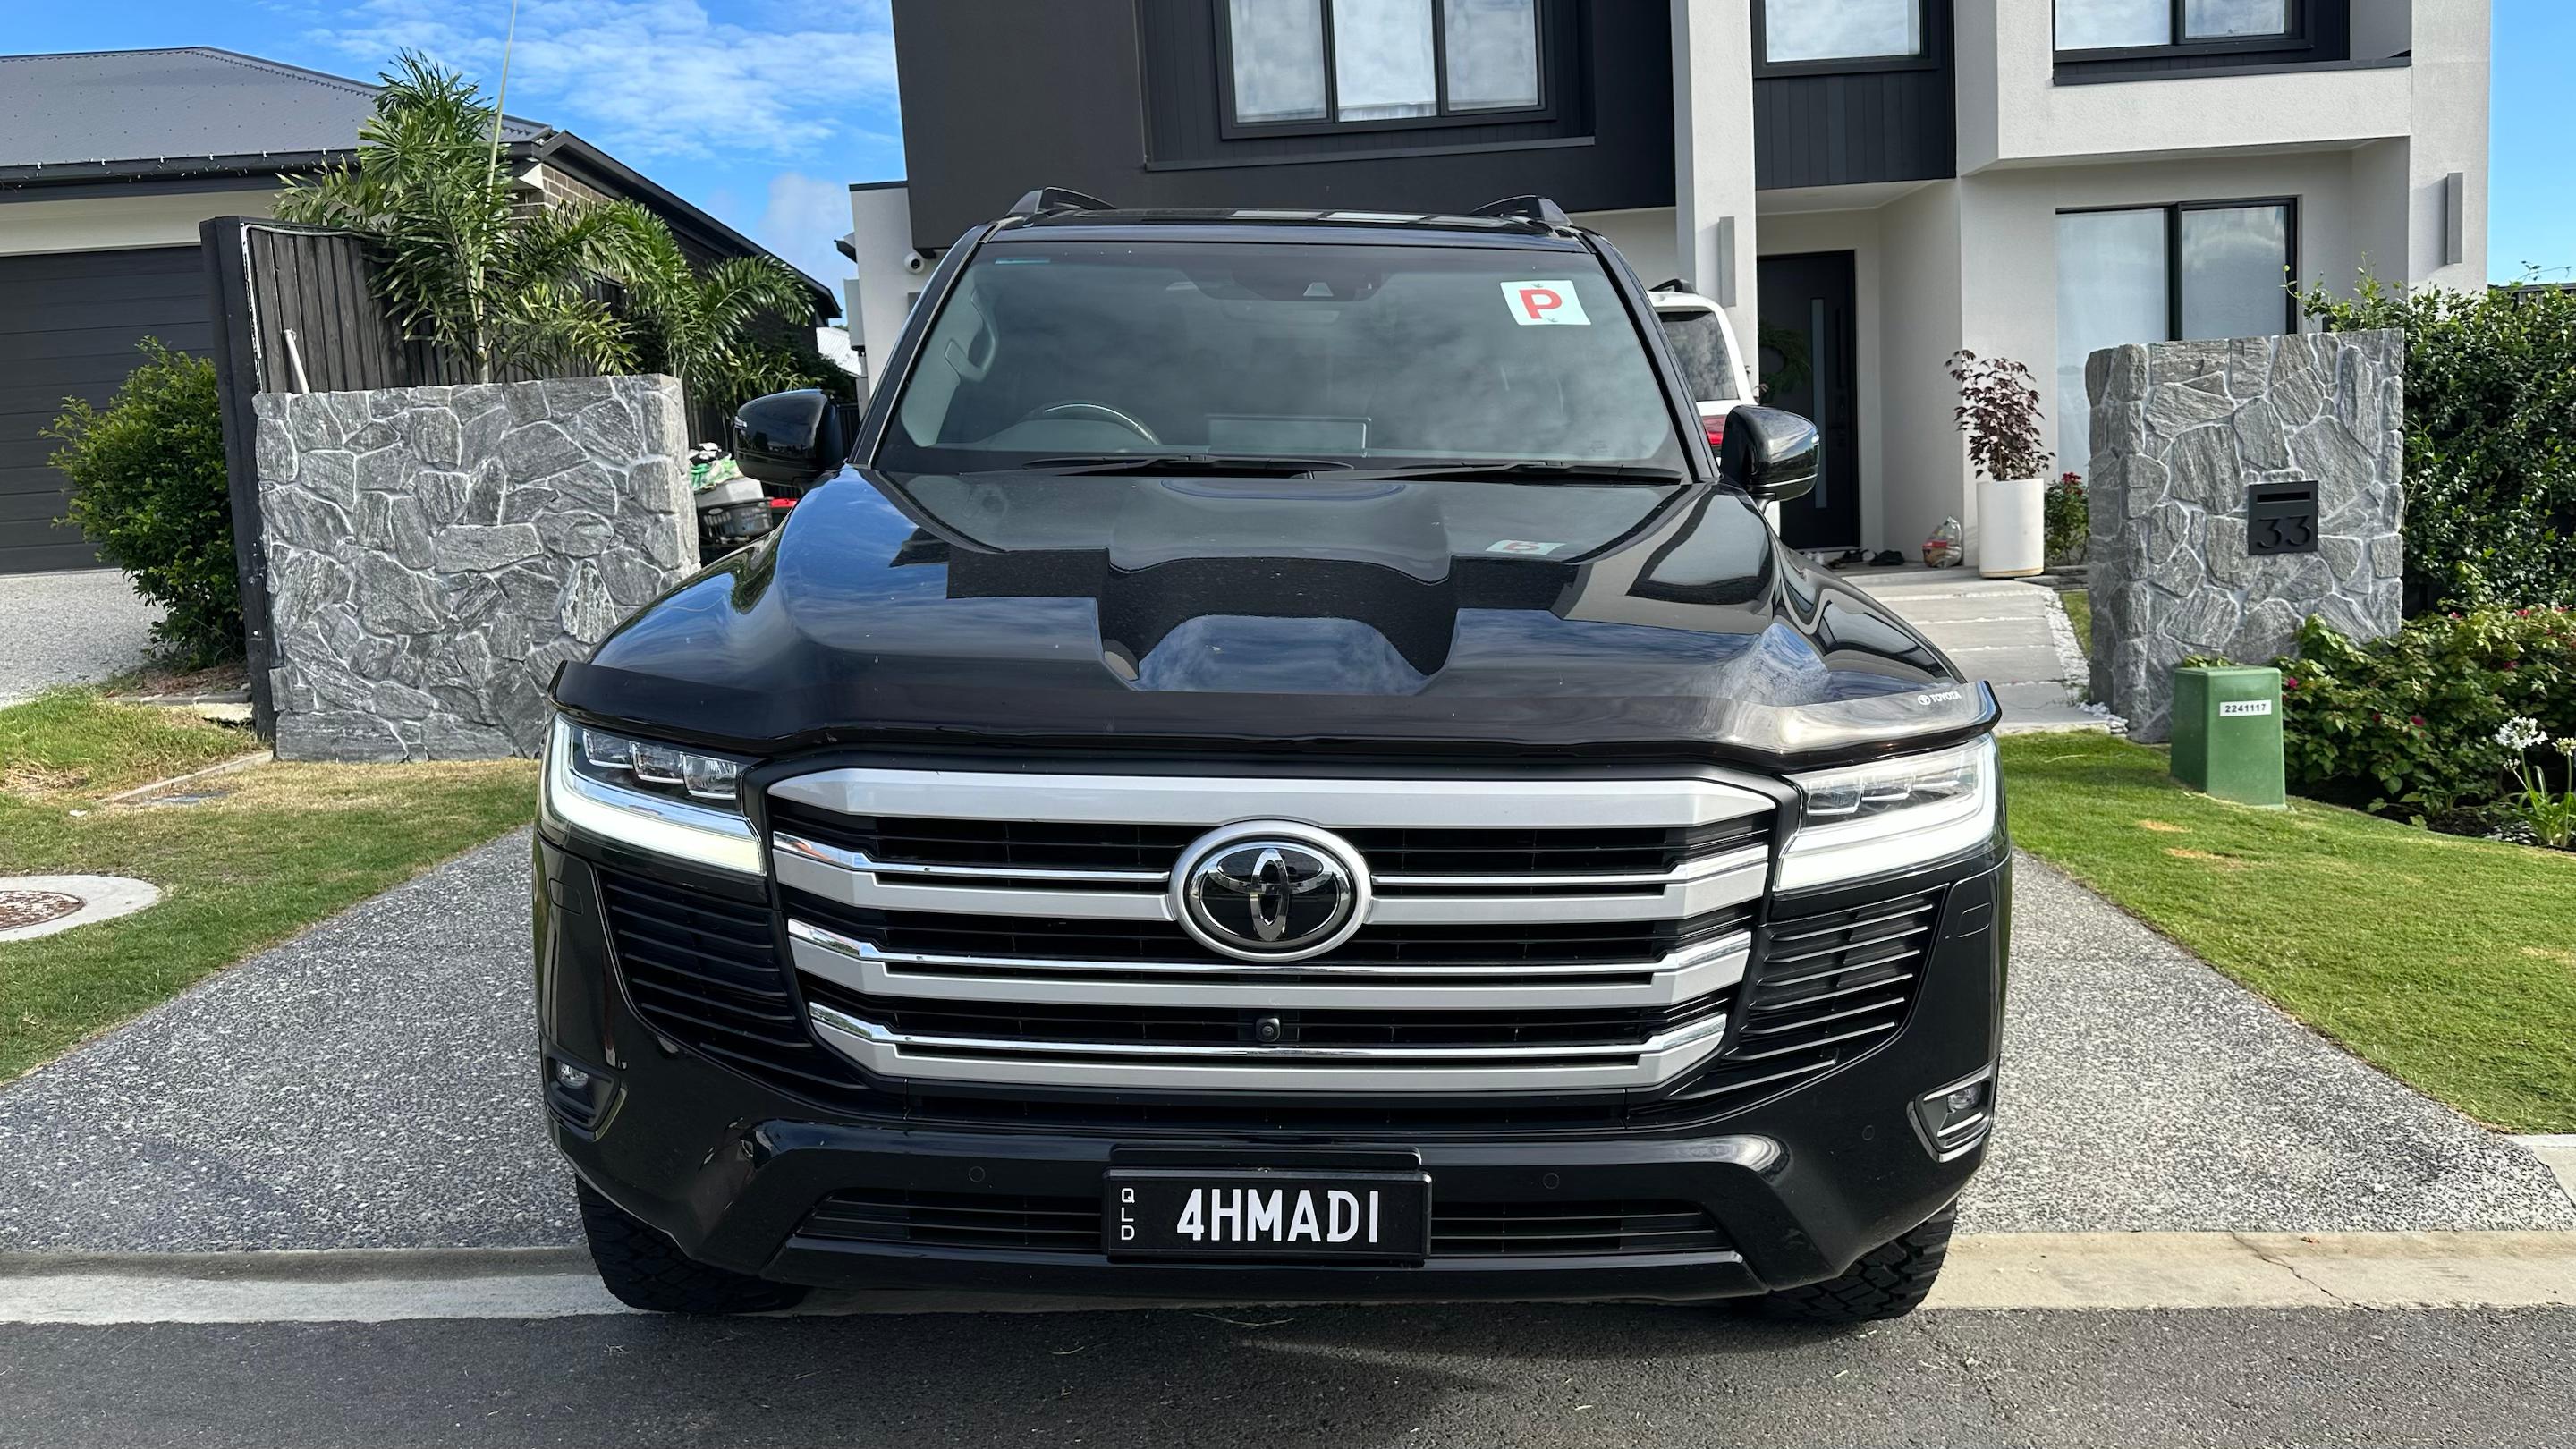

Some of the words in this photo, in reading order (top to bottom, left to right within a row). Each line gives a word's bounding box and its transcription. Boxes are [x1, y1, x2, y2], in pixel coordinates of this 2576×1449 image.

[1519, 289, 1563, 319] P
[2256, 515, 2311, 548] 33
[1929, 691, 1962, 703] TOYOTA
[2224, 703, 2267, 713] 2241117
[1121, 1187, 1135, 1241] QLD
